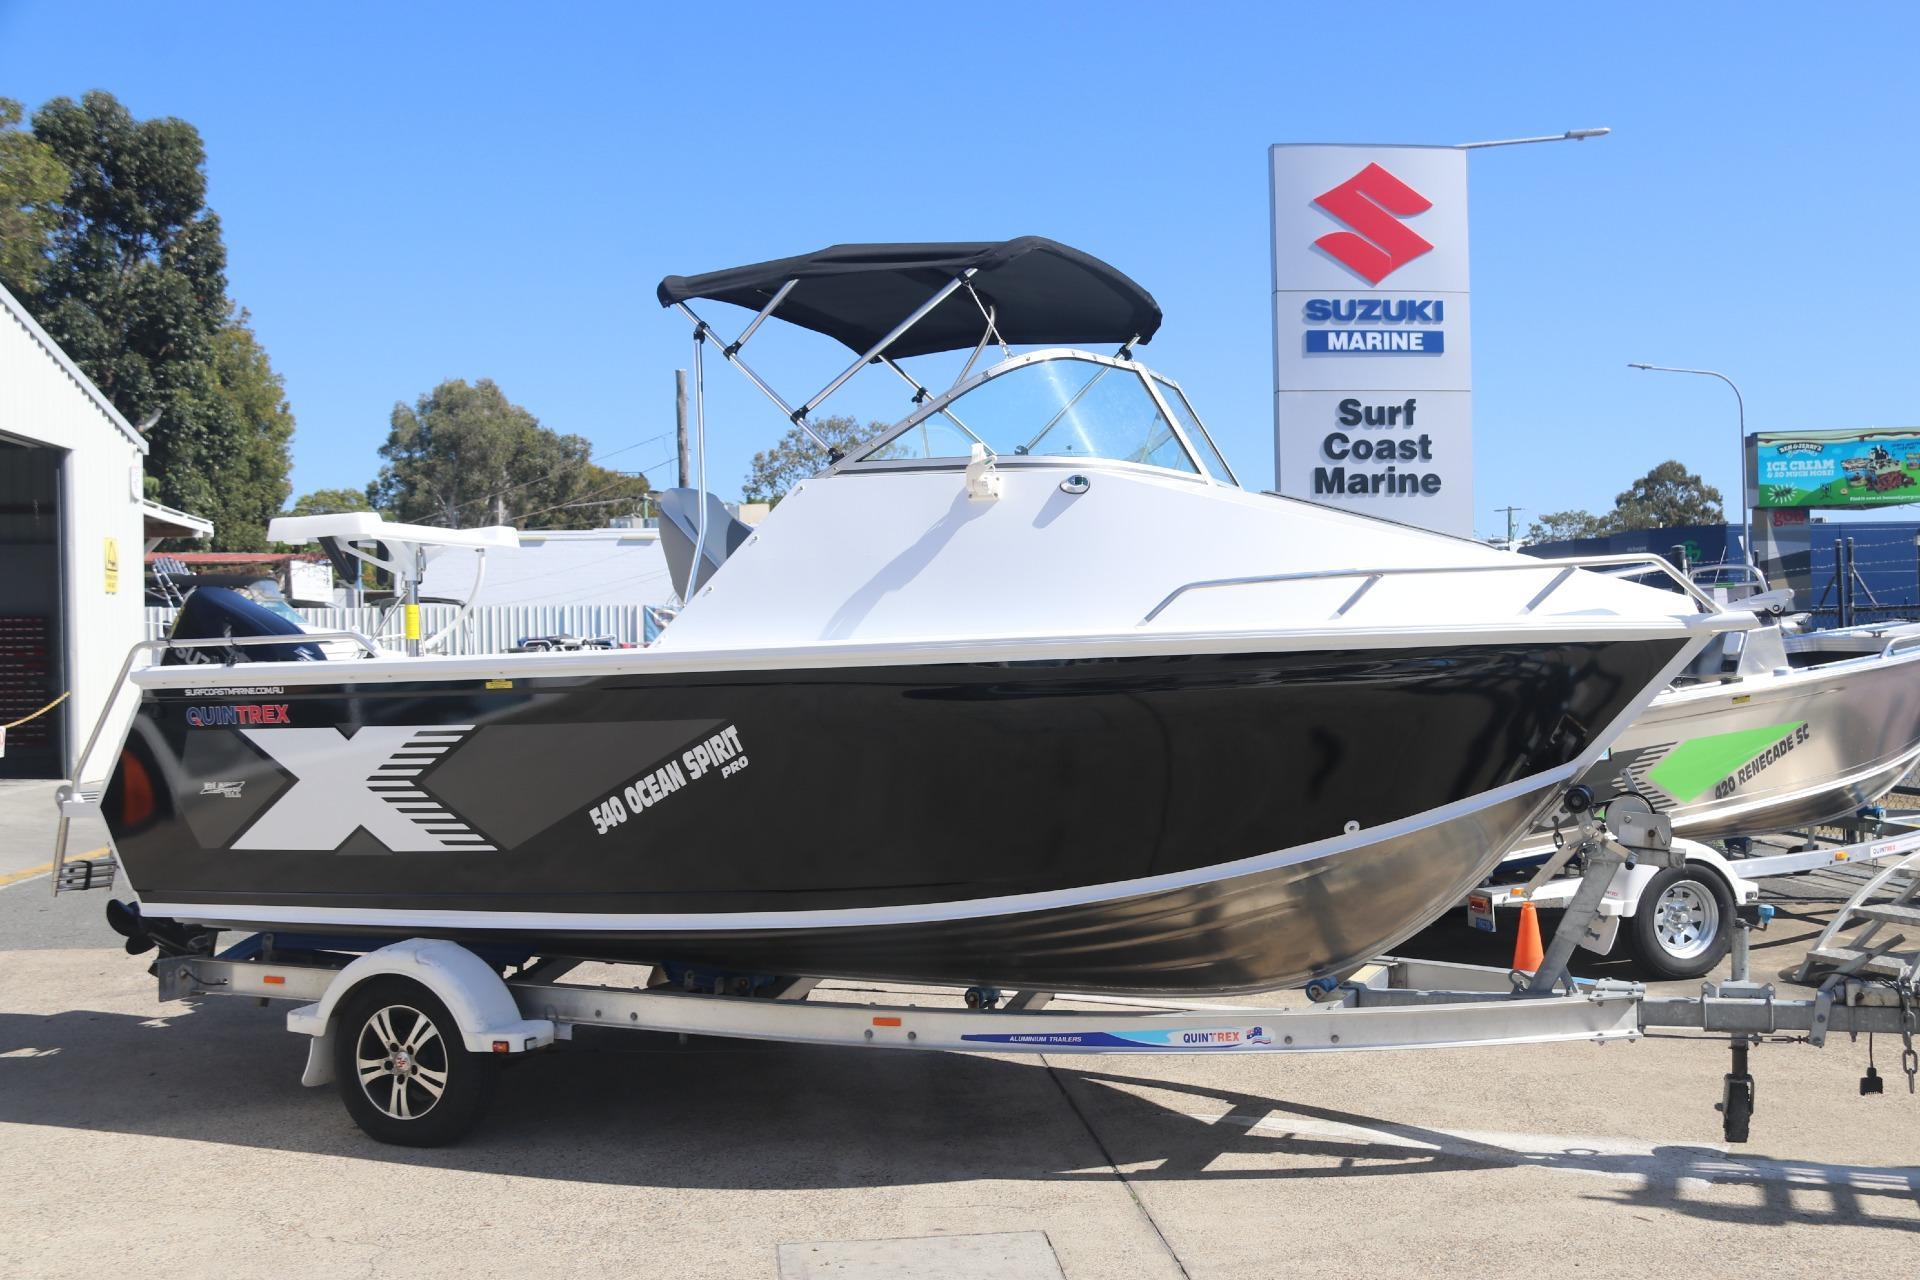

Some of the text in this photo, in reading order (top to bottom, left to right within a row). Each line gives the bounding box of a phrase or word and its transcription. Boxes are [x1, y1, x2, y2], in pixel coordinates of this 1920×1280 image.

[1305, 298, 1444, 322] SUZUKI
[1327, 331, 1424, 351] MARINE
[1339, 398, 1417, 426] Surf
[1323, 432, 1433, 460] Coast
[1766, 461, 1788, 472] ICE
[1789, 459, 1835, 471] CREAM
[1314, 466, 1442, 494] Marine
[186, 704, 291, 727] QUINTREX
[720, 755, 749, 779] PRO
[1714, 723, 1810, 801] 420 RENEGADE SC
[588, 724, 744, 835] 540 OCEAN SPIRIT
[1009, 1035, 1047, 1043] ALUMINIUM
[1183, 1031, 1240, 1044] QUINTREX
